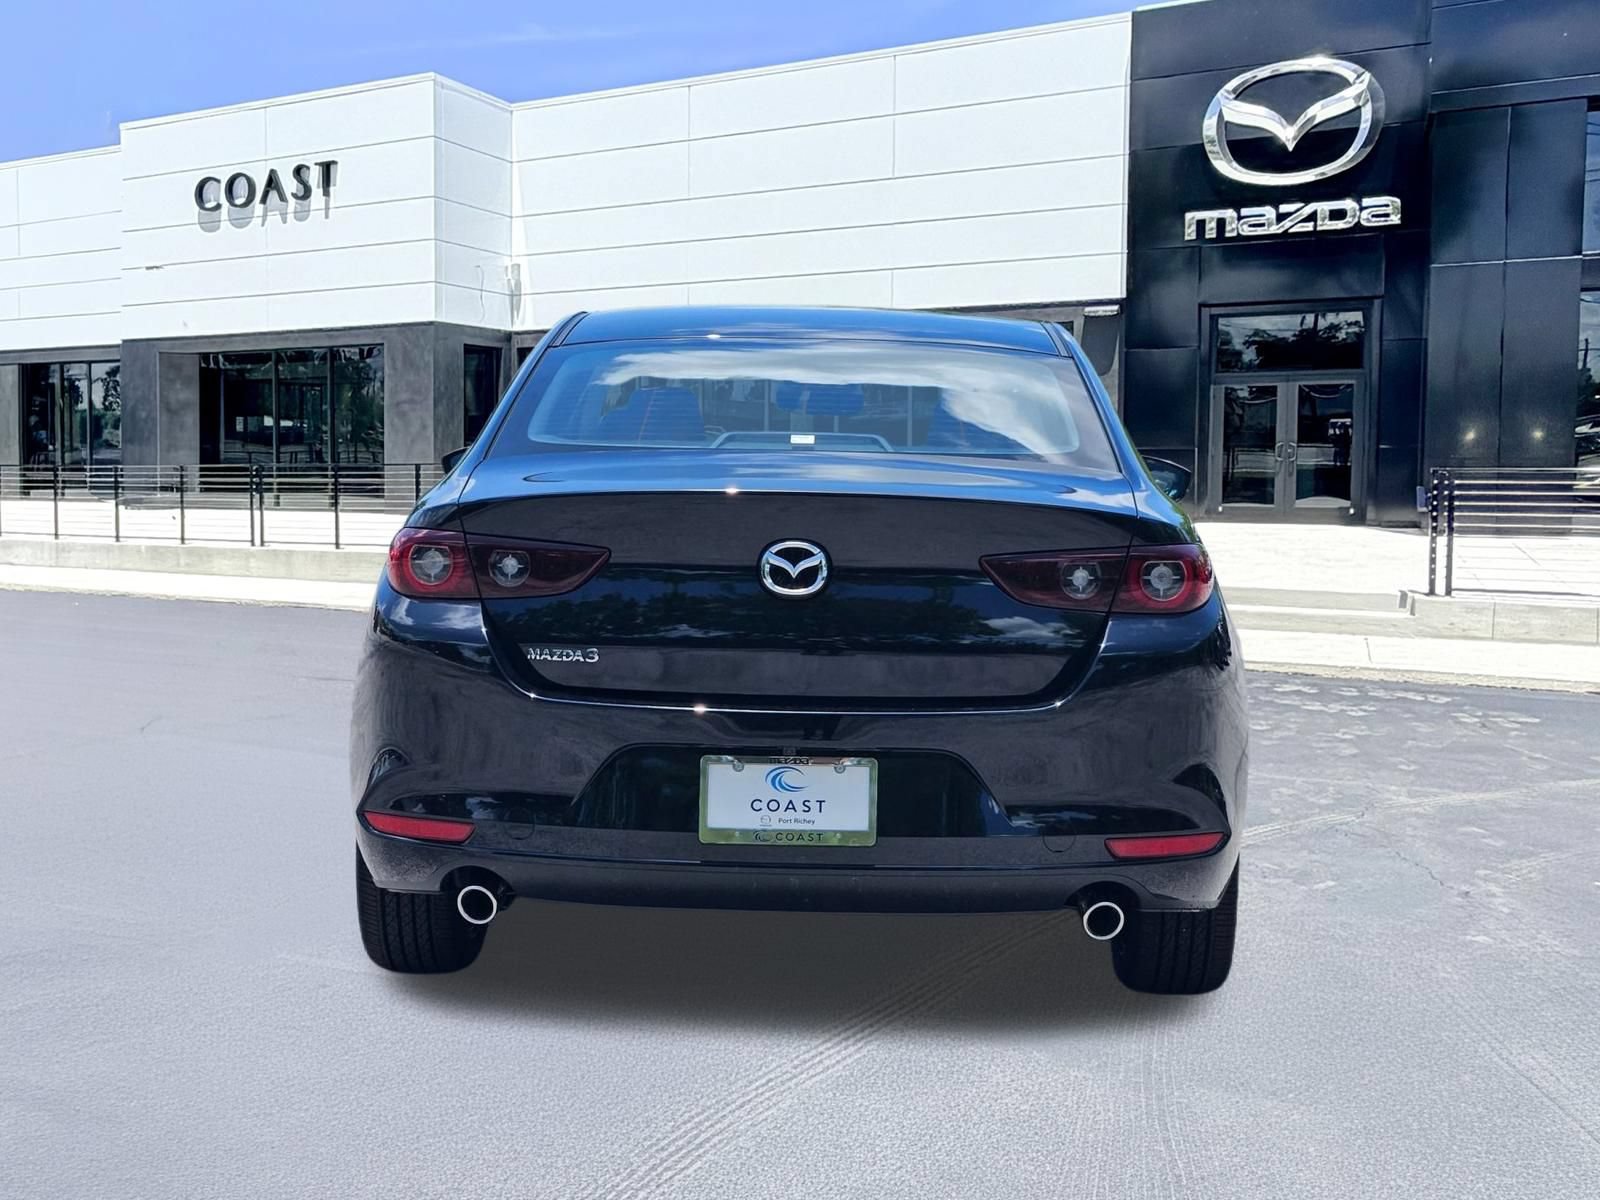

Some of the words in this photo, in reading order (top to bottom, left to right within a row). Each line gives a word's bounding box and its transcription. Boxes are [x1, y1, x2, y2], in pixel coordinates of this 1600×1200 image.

[194, 160, 338, 212] COAST
[527, 648, 600, 663] MAZDA3
[750, 798, 826, 813] COAST
[793, 817, 816, 826] Richey
[775, 832, 824, 842] COAST
